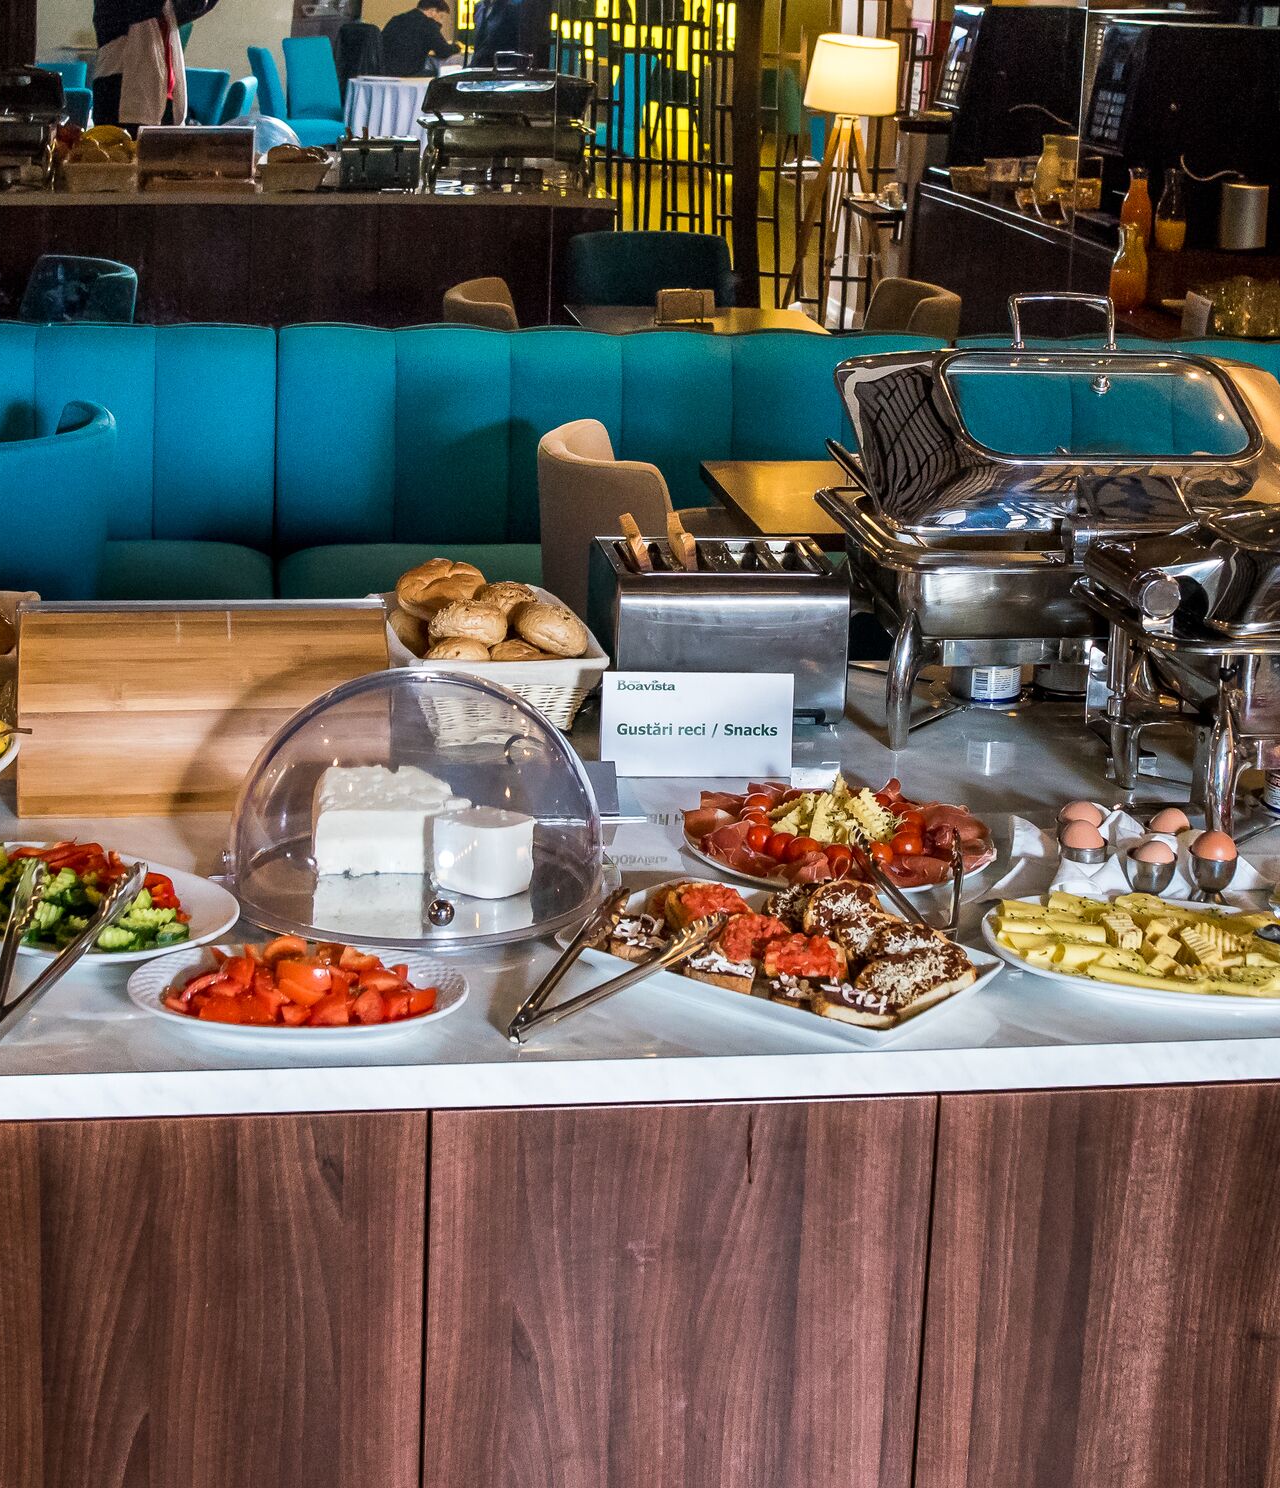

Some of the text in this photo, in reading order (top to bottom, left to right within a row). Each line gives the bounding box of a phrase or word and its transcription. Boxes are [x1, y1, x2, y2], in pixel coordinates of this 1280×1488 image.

[616, 679, 676, 691] Boavista
[616, 722, 778, 738] Gustări reci / Snacks
